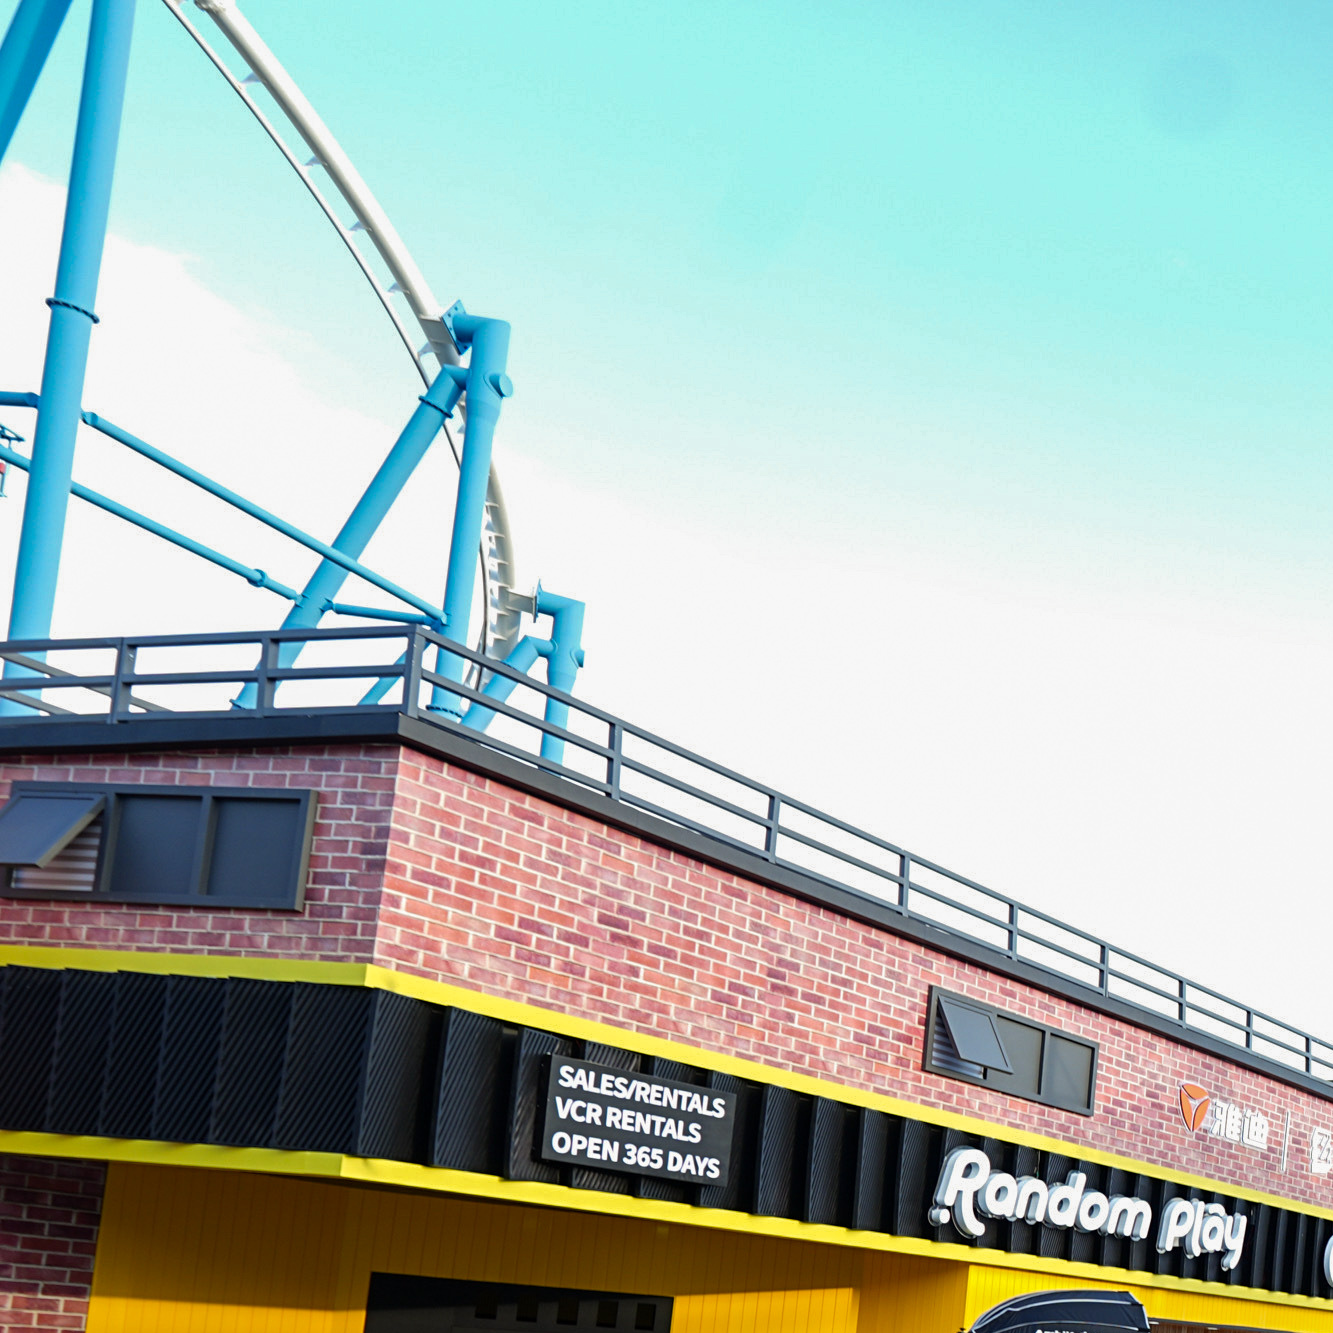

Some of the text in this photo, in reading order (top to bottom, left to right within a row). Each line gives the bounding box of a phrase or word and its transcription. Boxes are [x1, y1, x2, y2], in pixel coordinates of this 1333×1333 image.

[558, 1064, 726, 1119] SALES/RENTALS
[555, 1096, 702, 1143] VCR RENTALS
[551, 1131, 721, 1179] OPEN 365 DAYS
[928, 1146, 1248, 1271] Random Play
